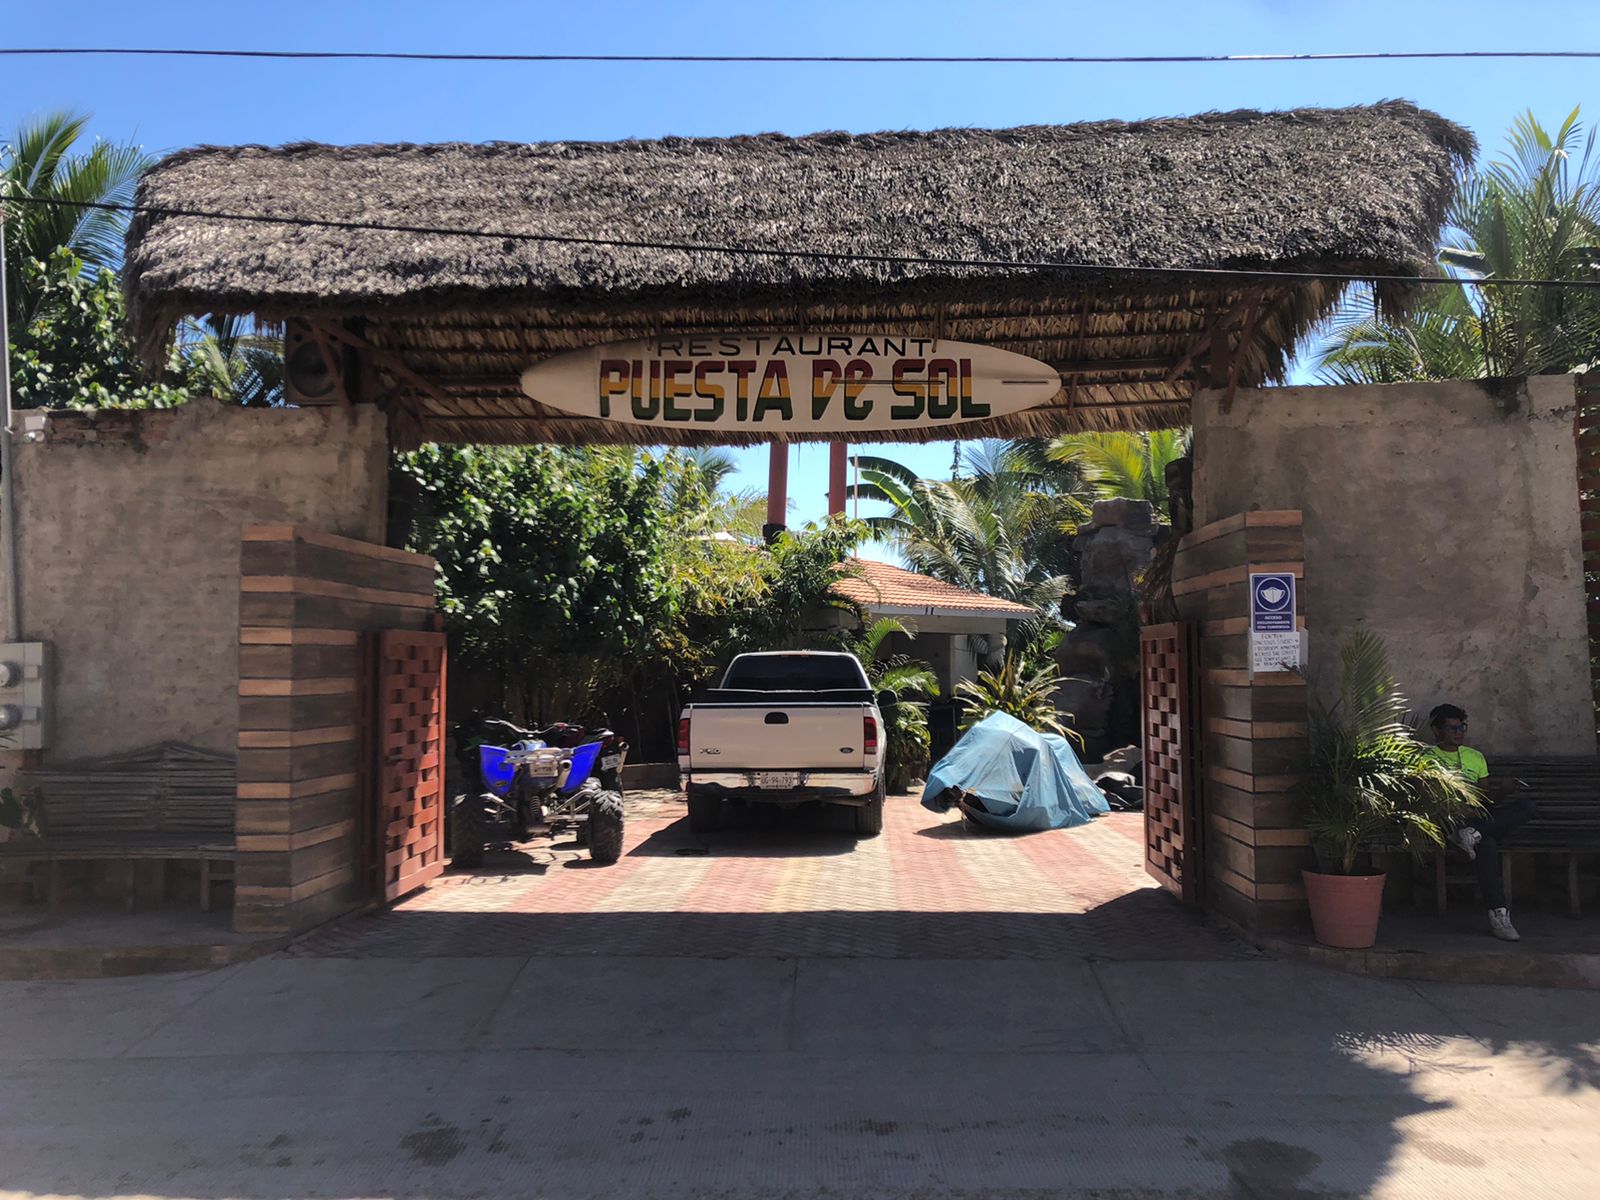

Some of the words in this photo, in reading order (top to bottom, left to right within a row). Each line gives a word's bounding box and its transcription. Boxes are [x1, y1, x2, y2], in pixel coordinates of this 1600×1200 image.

[657, 336, 932, 357] RESTAURANT
[600, 359, 793, 422] PUESTA
[891, 359, 991, 420] SOL
